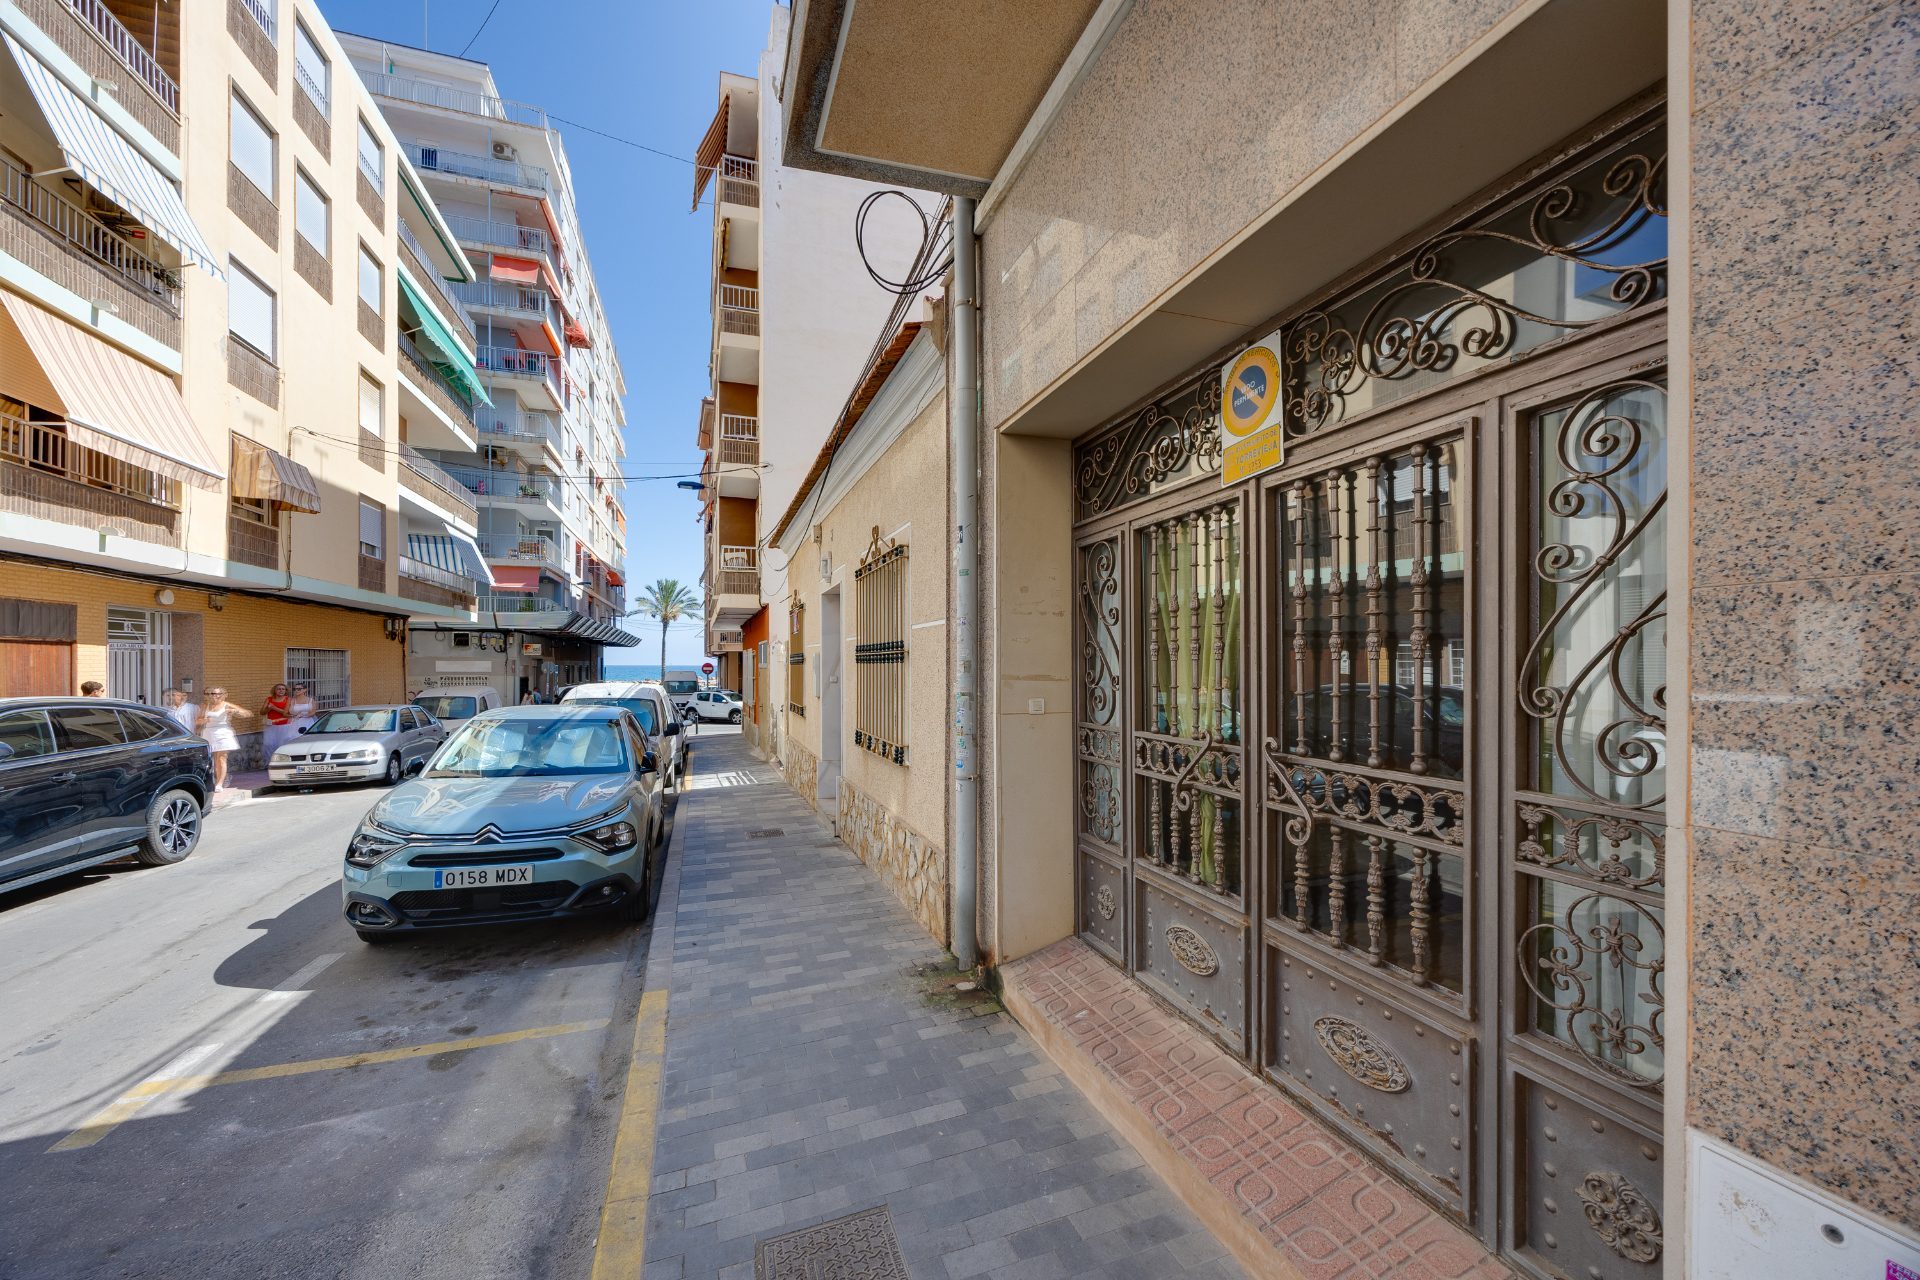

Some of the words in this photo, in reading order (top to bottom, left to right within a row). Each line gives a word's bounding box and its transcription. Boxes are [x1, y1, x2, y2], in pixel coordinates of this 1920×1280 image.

[1234, 384, 1265, 408] PERMANENTE
[1236, 440, 1278, 465] TORREVIEJA
[445, 870, 488, 886] 0158
[495, 867, 528, 883] MDX
